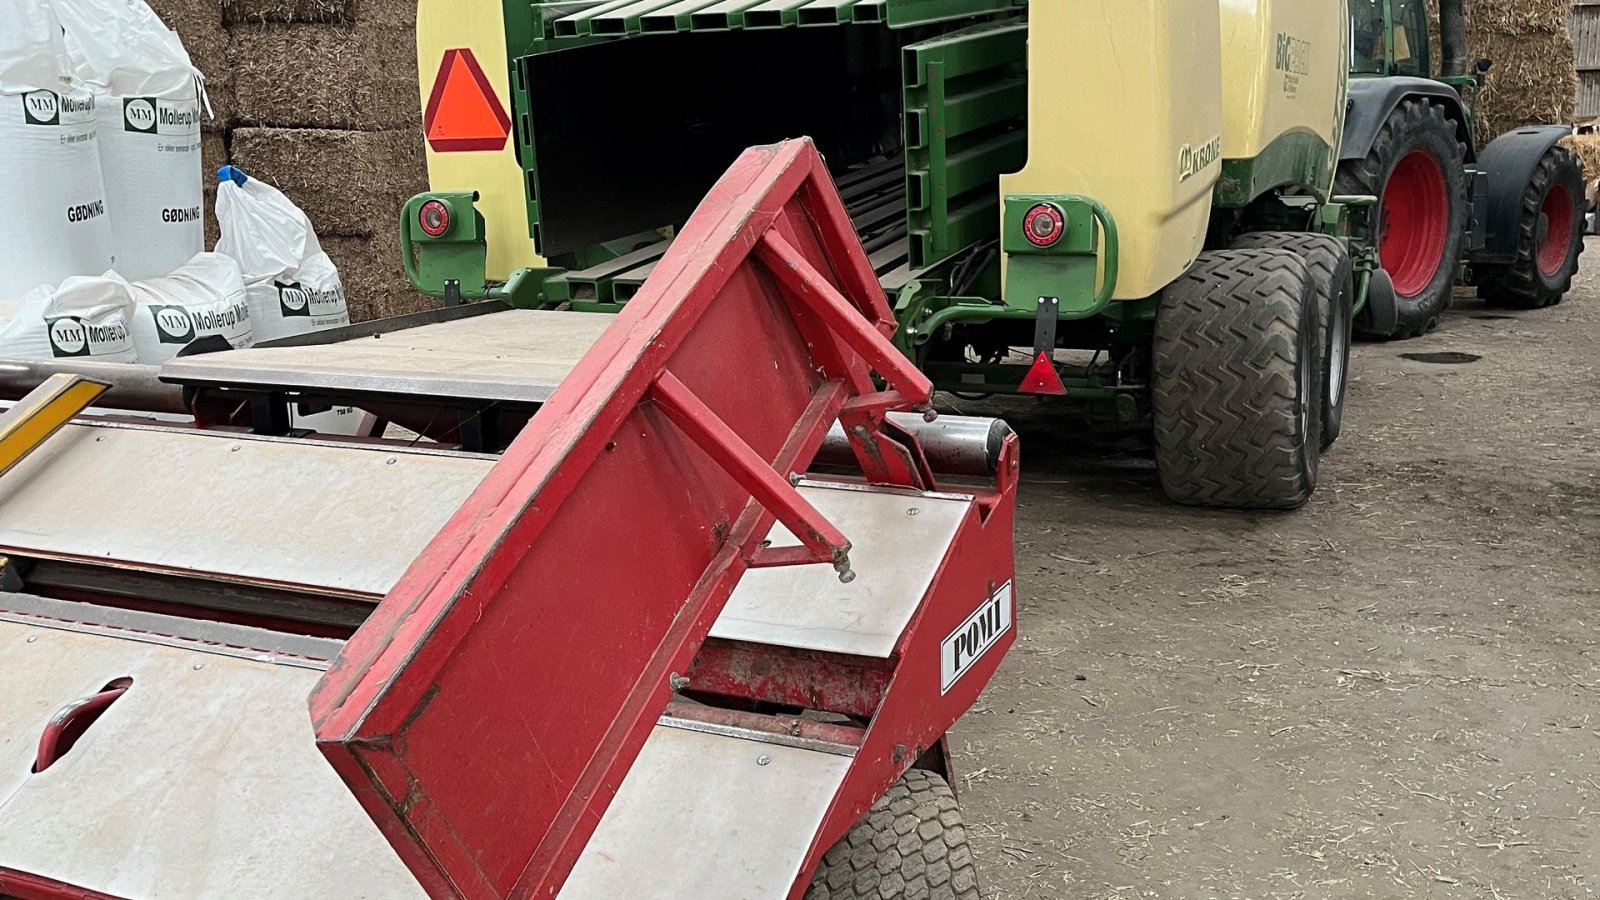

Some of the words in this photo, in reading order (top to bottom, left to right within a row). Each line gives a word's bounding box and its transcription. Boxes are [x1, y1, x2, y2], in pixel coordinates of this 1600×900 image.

[30, 97, 54, 111] MM
[129, 107, 153, 121] MM
[1192, 136, 1220, 175] KRONE
[68, 200, 104, 222] GØDNING
[162, 206, 200, 222] GØDNING
[285, 290, 304, 303] MM
[161, 315, 187, 329] MM
[192, 309, 236, 330] Mollerup
[56, 329, 82, 343] MM
[953, 597, 1002, 674] POMI
